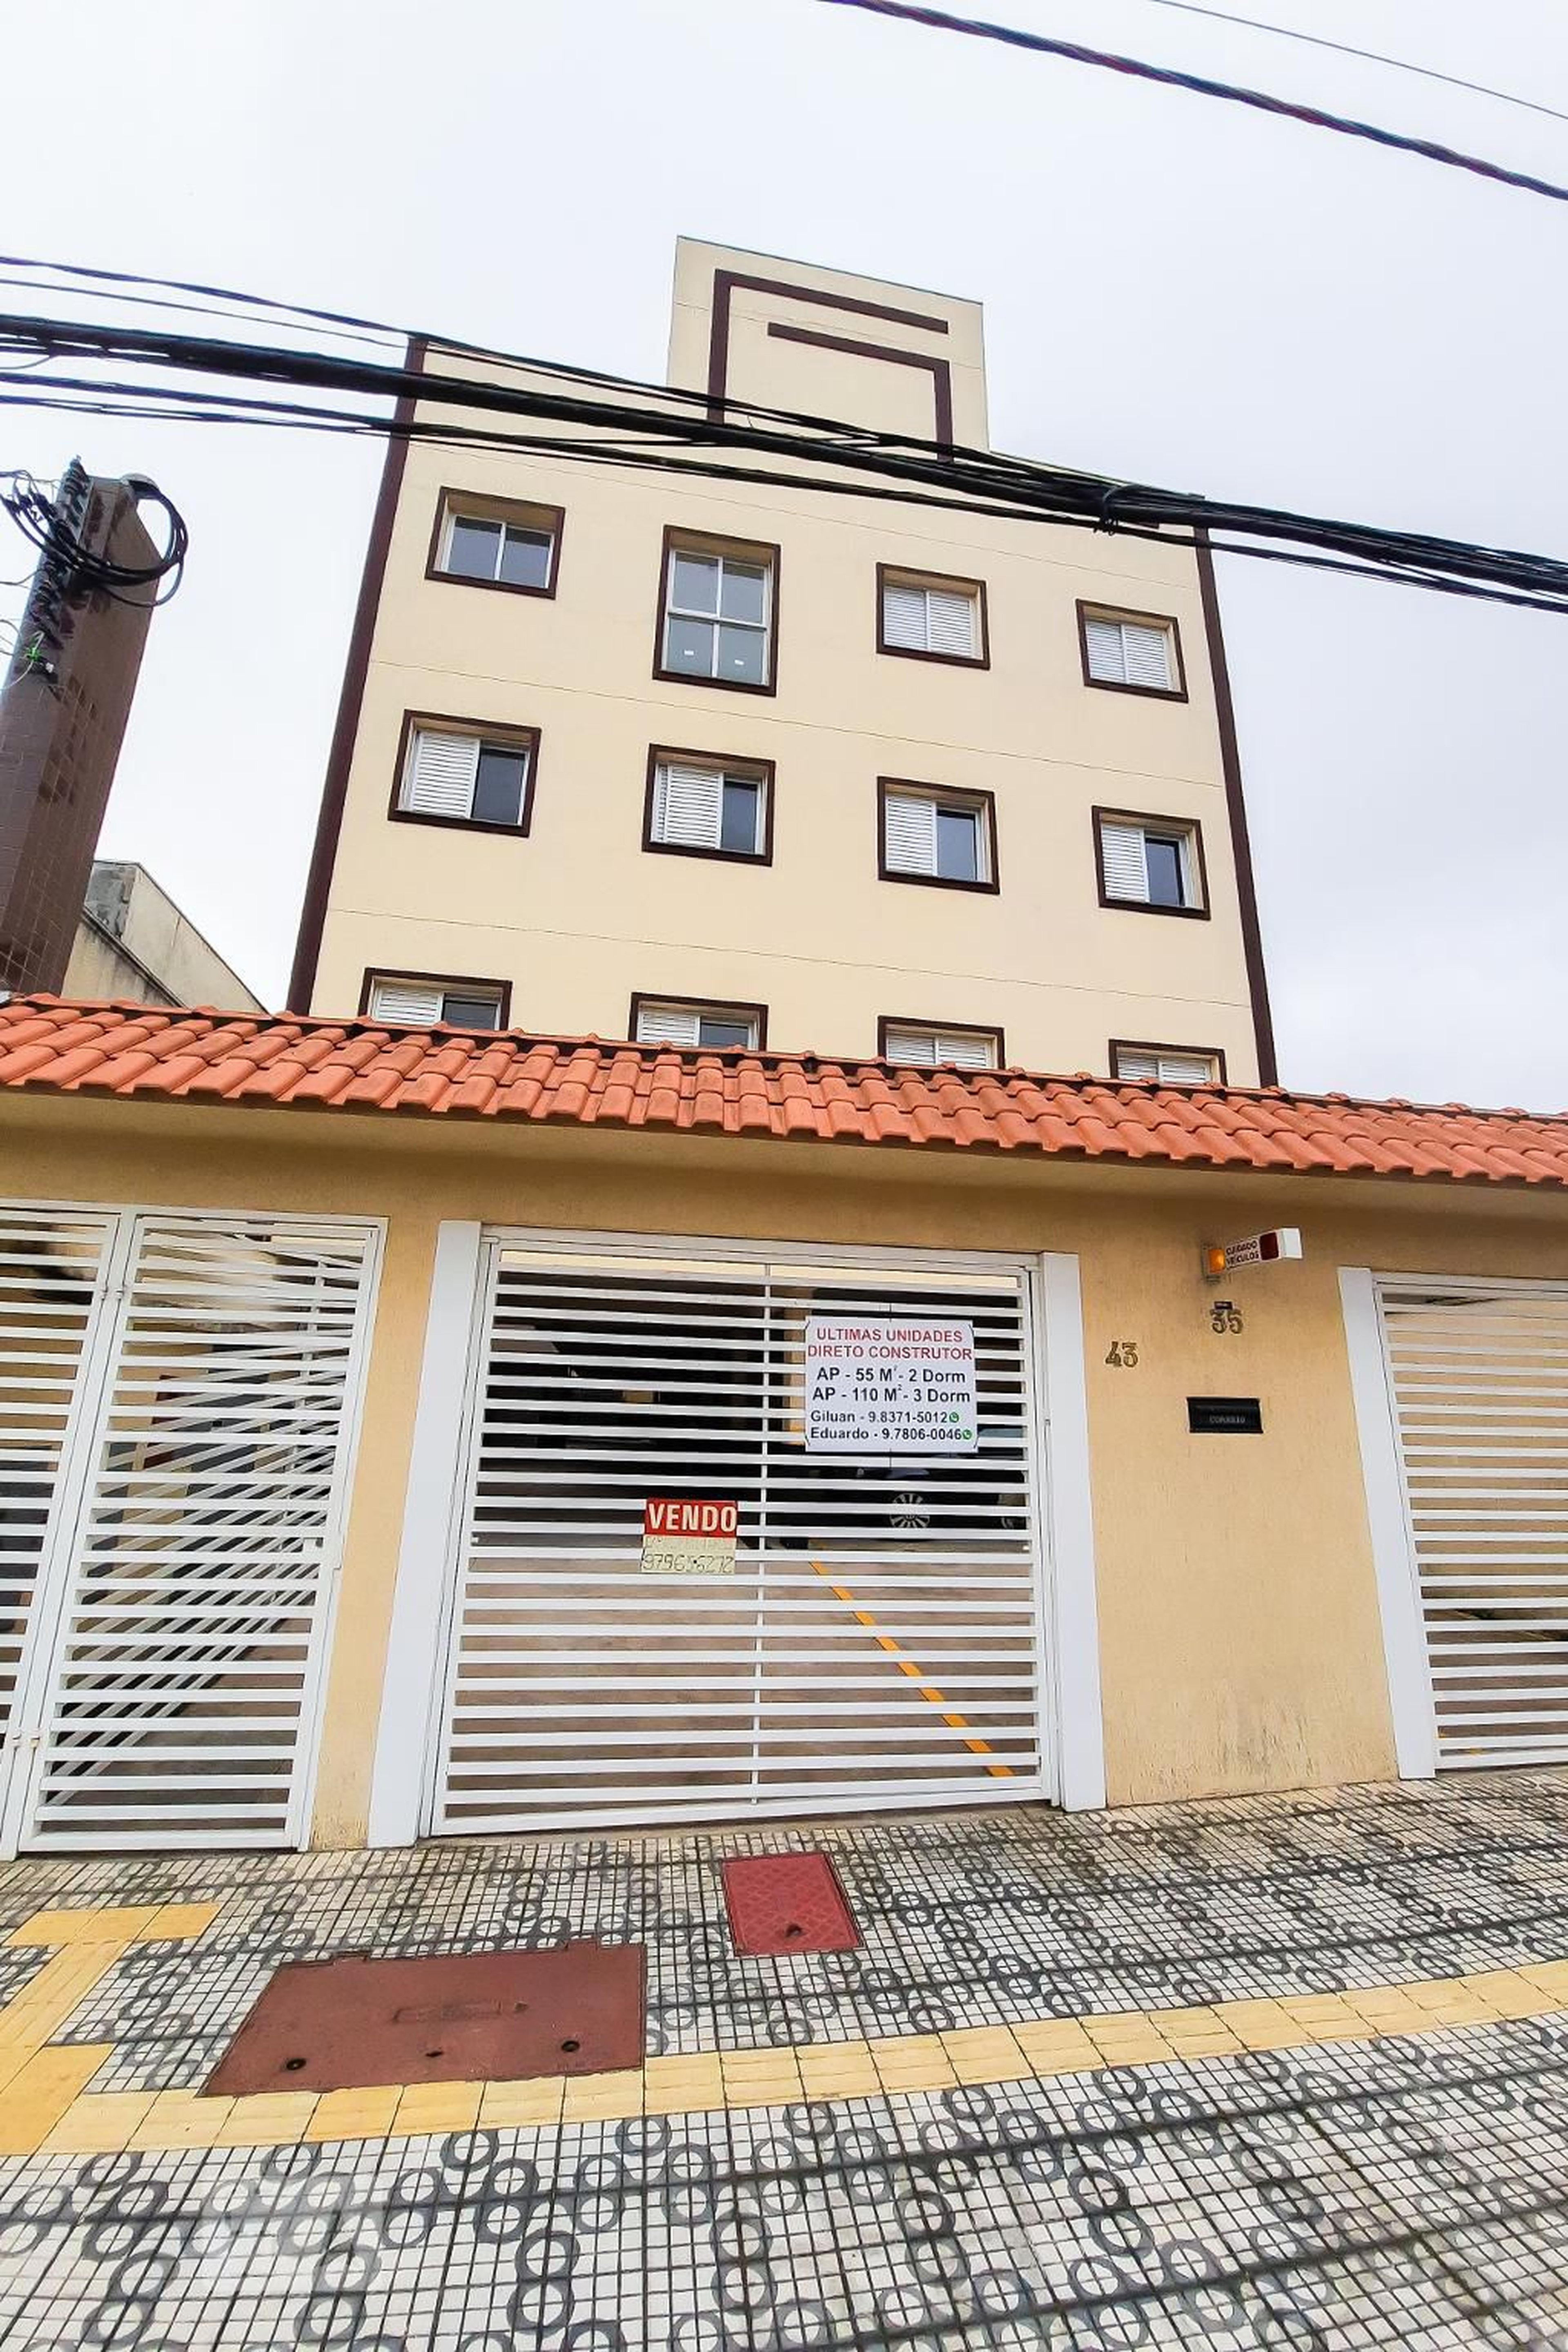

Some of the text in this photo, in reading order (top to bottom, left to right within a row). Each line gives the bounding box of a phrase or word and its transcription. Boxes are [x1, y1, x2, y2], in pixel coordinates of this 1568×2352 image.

[1210, 1308, 1243, 1334] 35
[817, 1328, 962, 1342] ULTIMAS UNIDADES
[808, 1345, 972, 1360] DIRETO CONSTRUTOR
[1105, 1341, 1138, 1368] 43
[817, 1367, 840, 1381] AP
[856, 1368, 874, 1381] 55
[909, 1368, 917, 1382] 2
[923, 1369, 965, 1383] Dorm
[813, 1387, 835, 1401] AP
[853, 1387, 878, 1401] 110
[914, 1388, 922, 1402] 3
[927, 1388, 970, 1402] Dorm
[811, 1410, 855, 1422] Giluan
[811, 1427, 869, 1439] Eduardo
[882, 1428, 962, 1440] 9.7806-0046
[648, 1503, 737, 1532] VENDO
